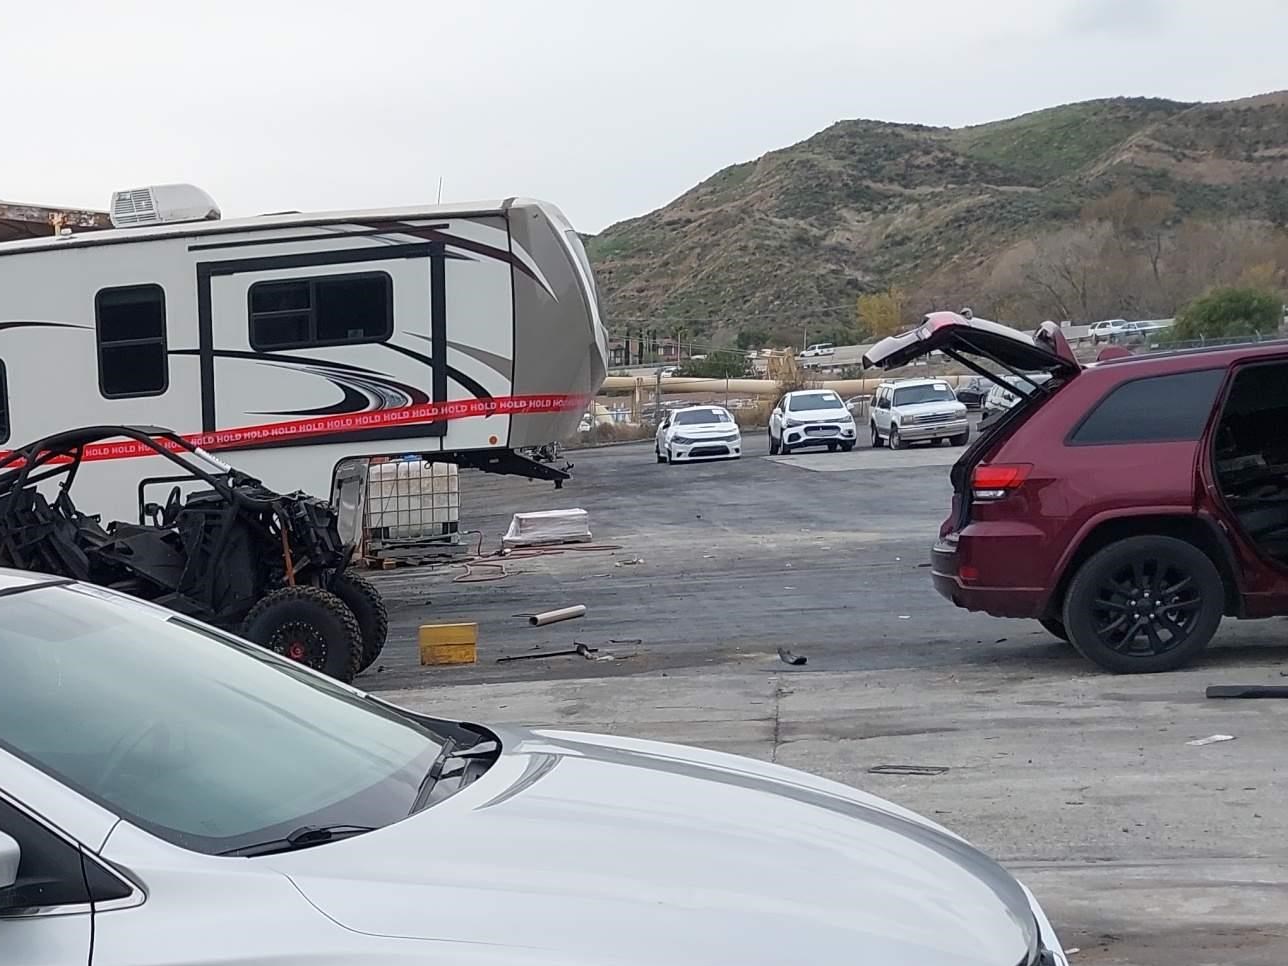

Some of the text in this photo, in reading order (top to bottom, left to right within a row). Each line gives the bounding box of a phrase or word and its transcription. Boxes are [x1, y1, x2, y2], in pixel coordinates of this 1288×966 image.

[86, 448, 109, 456] HOLD
[112, 446, 135, 454] HOLD
[191, 436, 214, 446] HOLD
[216, 433, 242, 444] HOLD
[243, 430, 268, 441] HOLD
[270, 426, 296, 436] HOLD
[299, 422, 324, 433] HOLD
[327, 418, 352, 428] HOLD
[355, 416, 380, 426] HOLD
[384, 412, 410, 422] HOLD
[412, 408, 438, 418] HOLD
[440, 404, 467, 415] HOLD
[470, 402, 496, 412] HOLD
[500, 400, 526, 408] HOLD
[528, 399, 552, 408] HOLD
